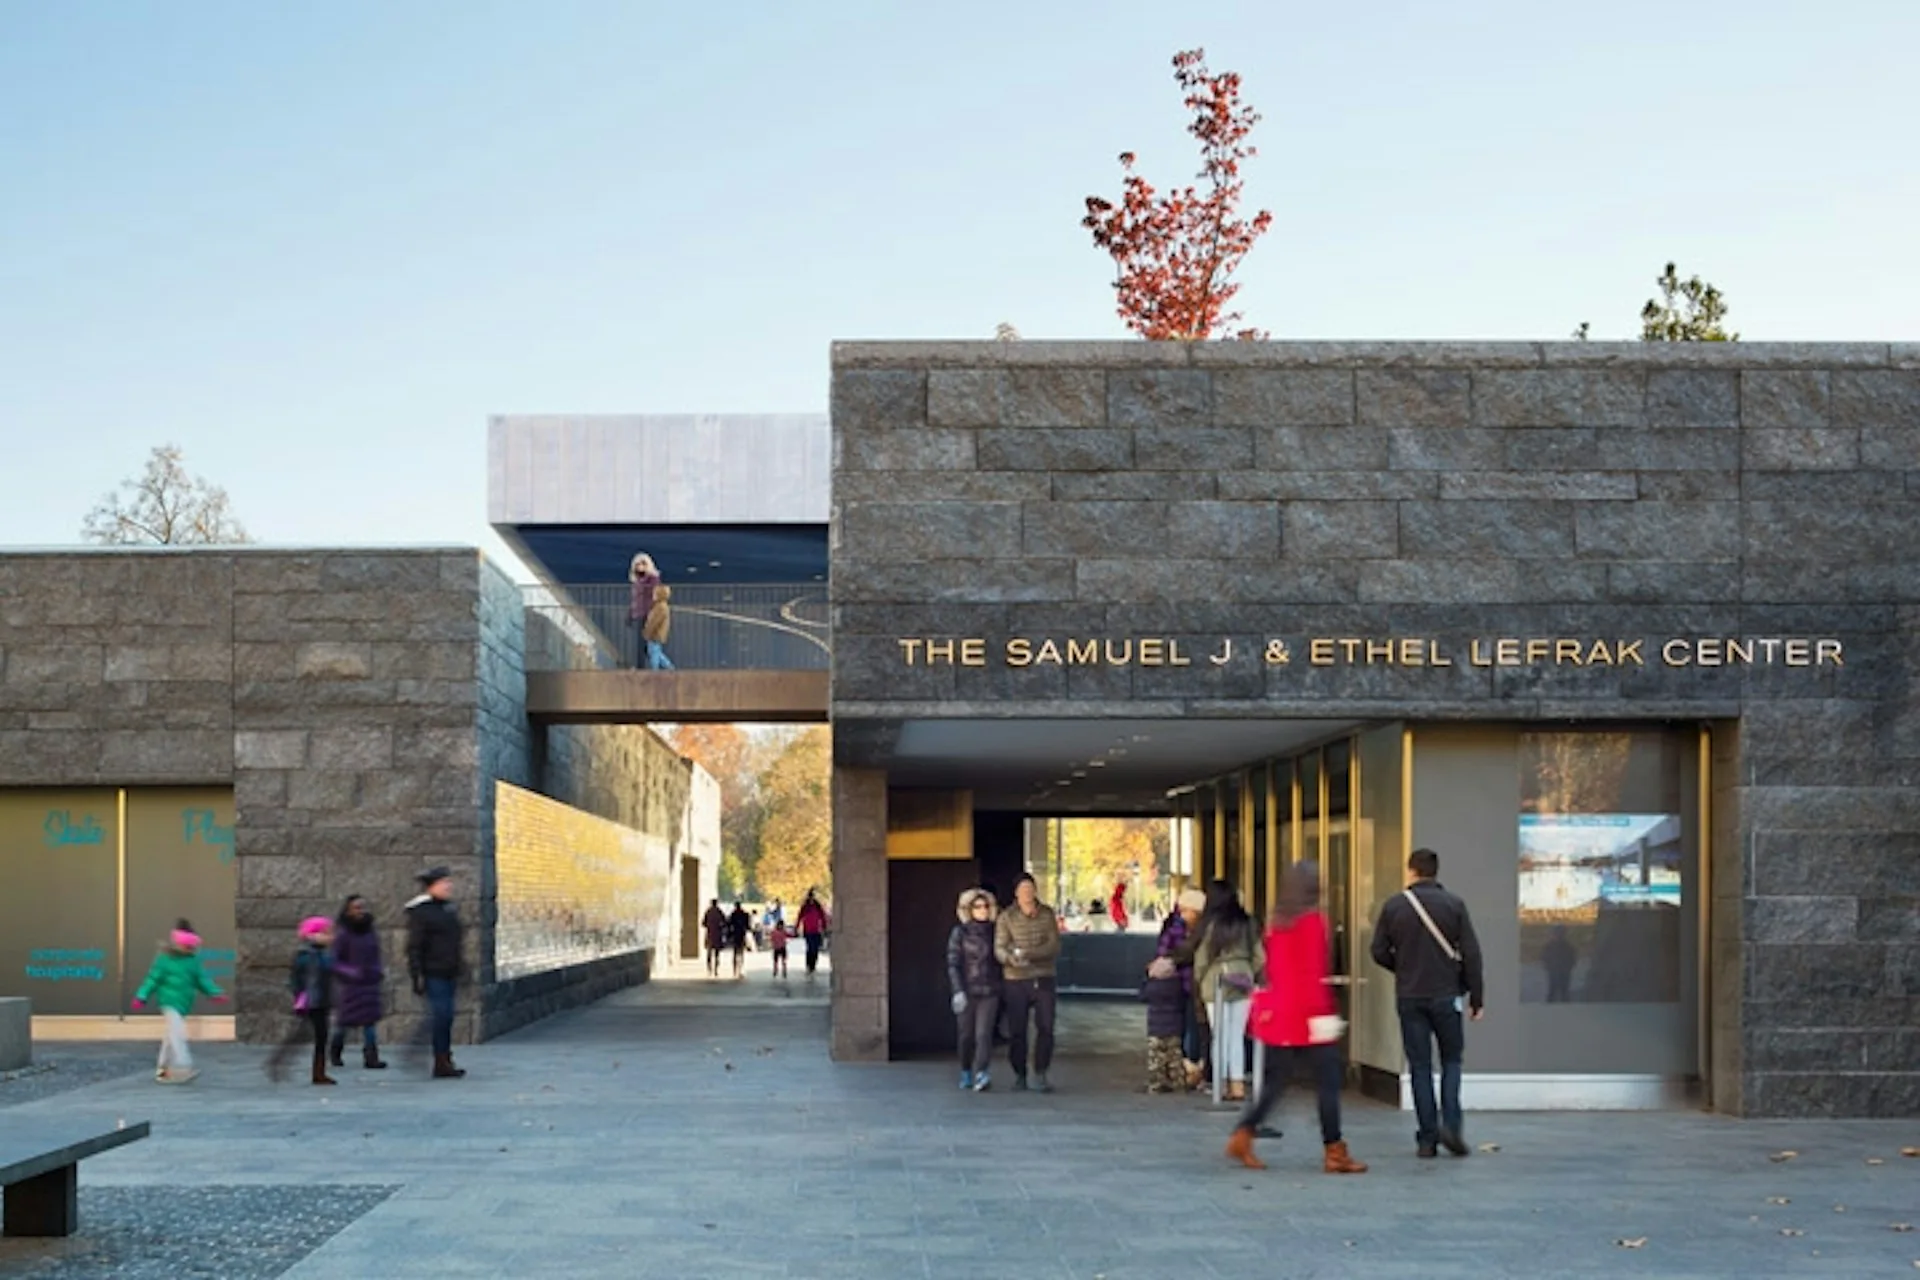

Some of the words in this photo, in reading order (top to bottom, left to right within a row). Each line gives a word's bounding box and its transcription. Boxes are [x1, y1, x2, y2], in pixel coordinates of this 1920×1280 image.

[898, 638, 986, 666] THE
[1005, 638, 1191, 666] SAMUEL
[1209, 638, 1232, 666] J
[1264, 638, 1290, 666] &
[1310, 638, 1452, 666] ETHEL
[1471, 638, 1644, 666] LEFRAK
[1662, 638, 1843, 666] CENTER
[25, 964, 104, 982] hospitality
